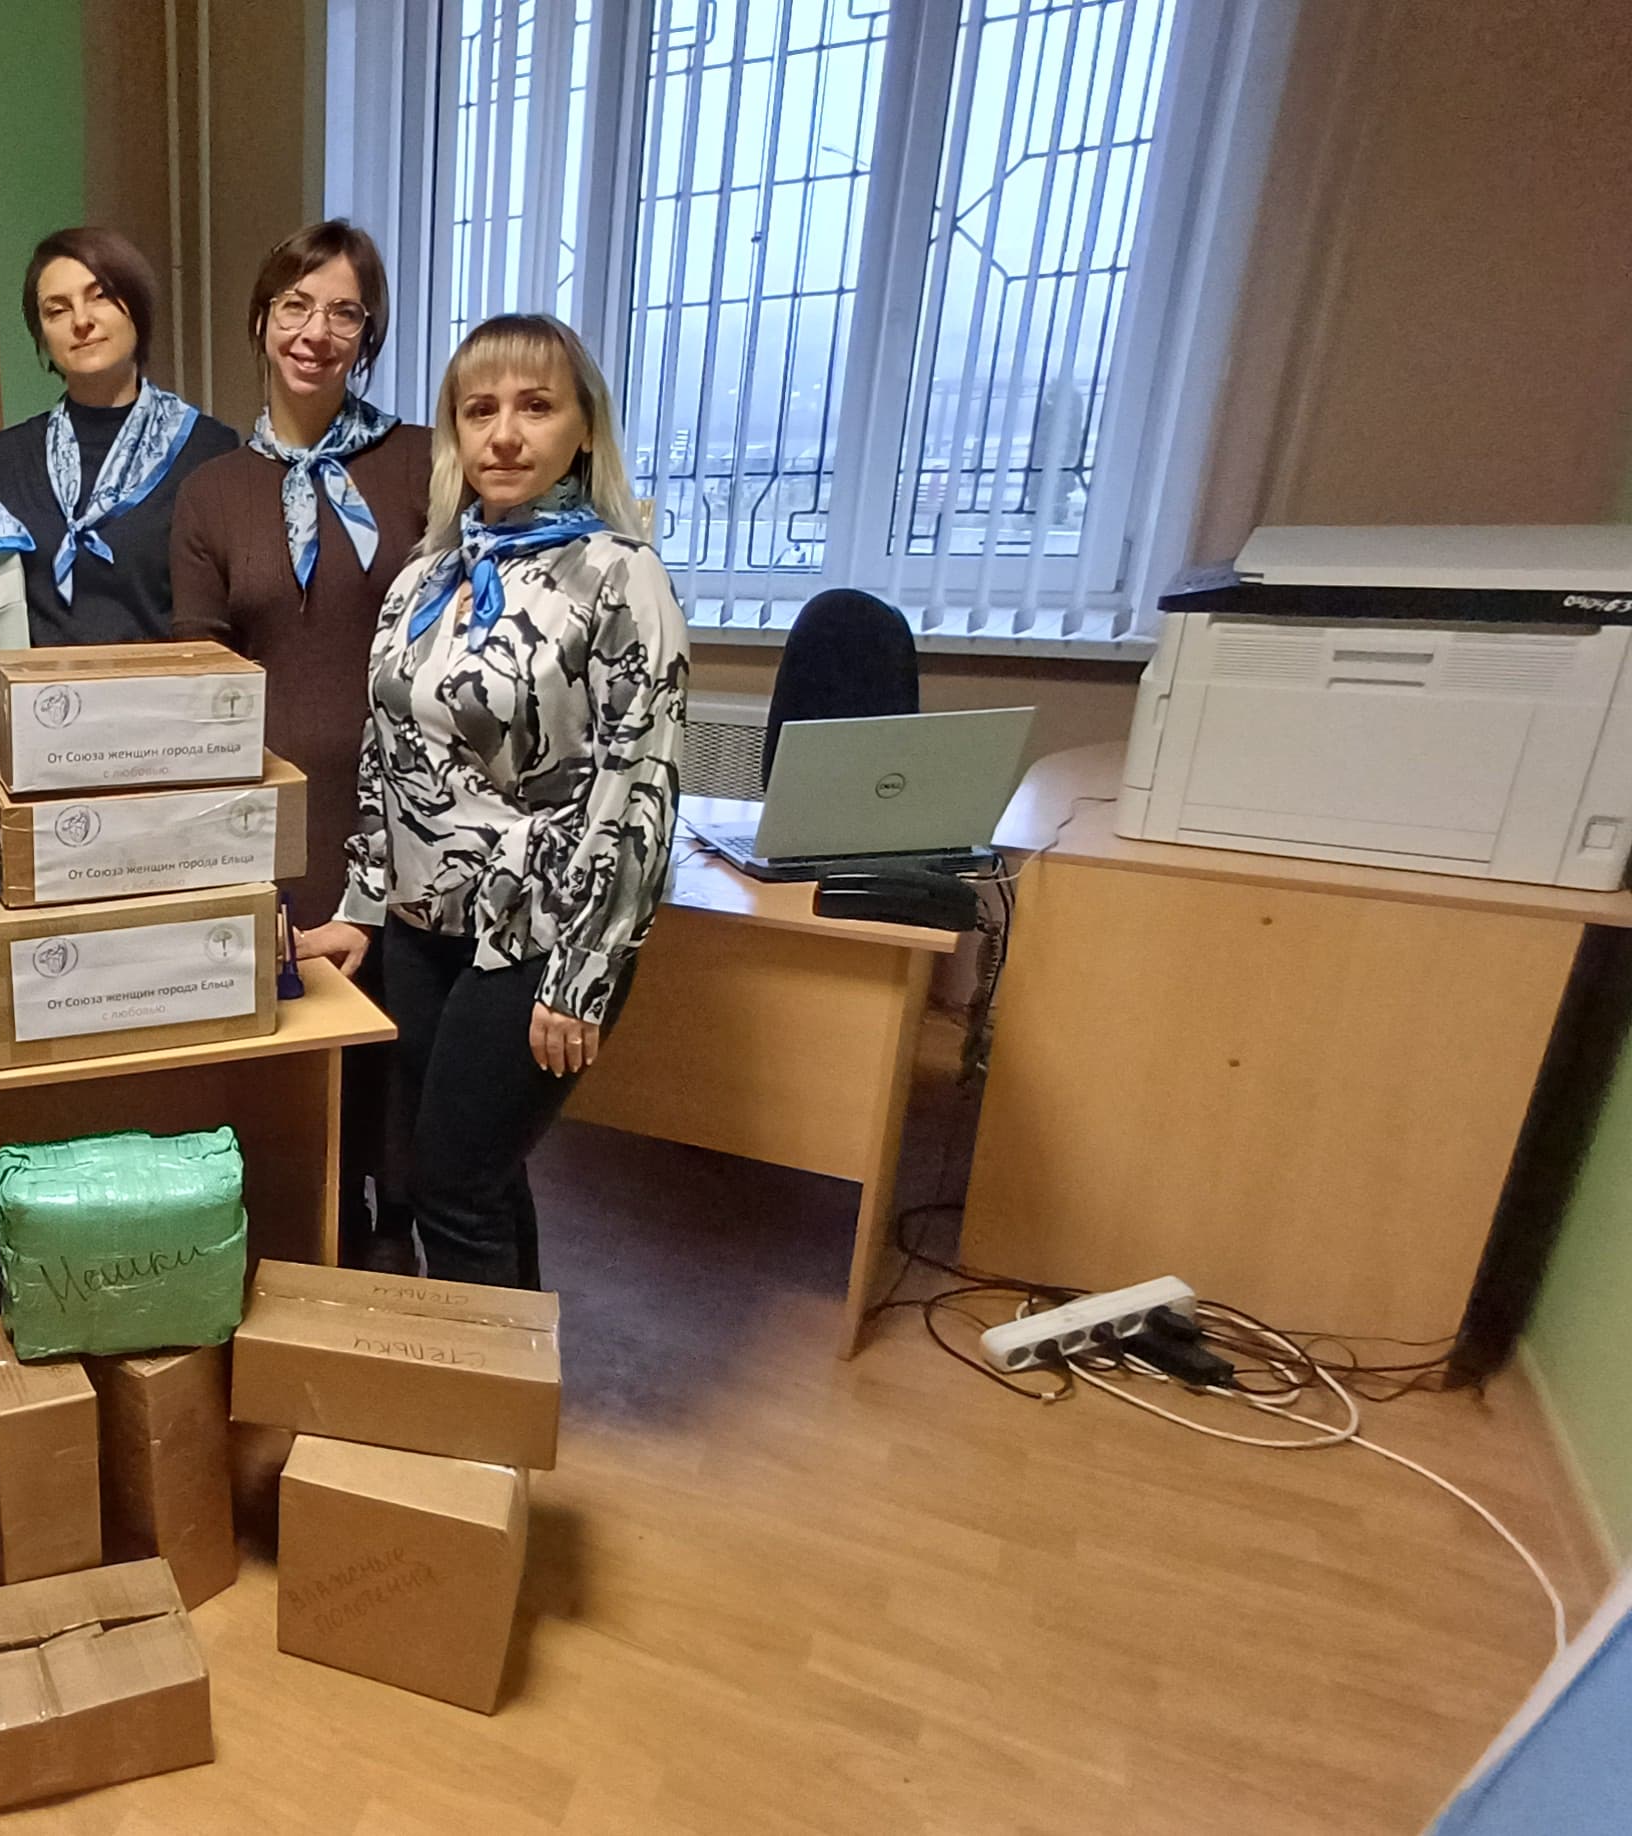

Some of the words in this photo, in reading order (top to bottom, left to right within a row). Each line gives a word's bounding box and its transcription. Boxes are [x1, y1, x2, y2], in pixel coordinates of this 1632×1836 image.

[48, 752, 62, 764] От
[66, 750, 104, 762] Союза
[108, 748, 159, 760] женщин
[161, 744, 203, 758] города
[206, 742, 241, 755] Ельца
[68, 869, 83, 880] От
[86, 866, 124, 879] Союза
[127, 863, 175, 875] женщин
[178, 857, 218, 871] города
[221, 853, 255, 866] Ельца
[47, 999, 63, 1010] От
[65, 995, 103, 1009] Союза
[106, 990, 155, 1002] женщин
[158, 983, 198, 997] города
[201, 979, 235, 991] Ельца
